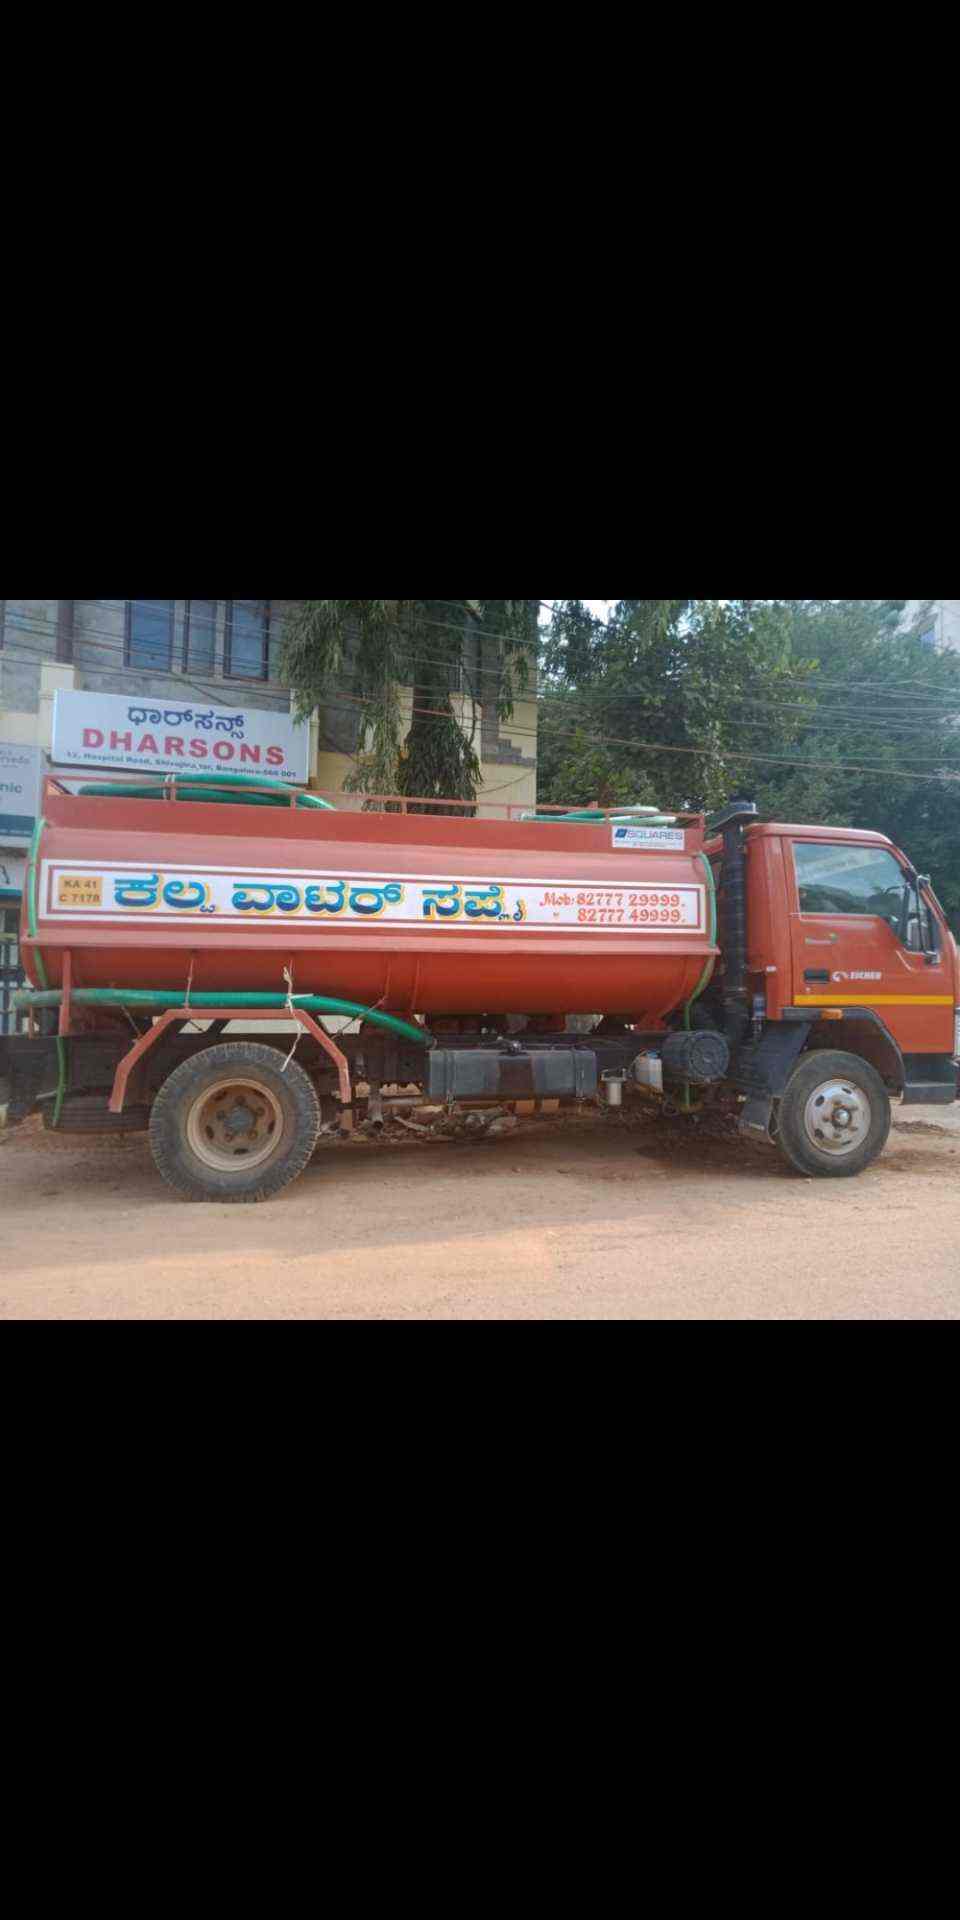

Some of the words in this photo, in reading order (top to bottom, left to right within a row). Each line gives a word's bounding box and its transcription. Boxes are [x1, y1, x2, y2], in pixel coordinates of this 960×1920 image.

[81, 727, 286, 766] DHARSONS
[84, 752, 124, 763] Hospital
[64, 879, 80, 889] KA
[84, 879, 97, 889] 41
[59, 893, 68, 903] C
[232, 880, 403, 915] ವಾಟರ್
[577, 892, 624, 906] 82777
[578, 908, 625, 922] 82777
